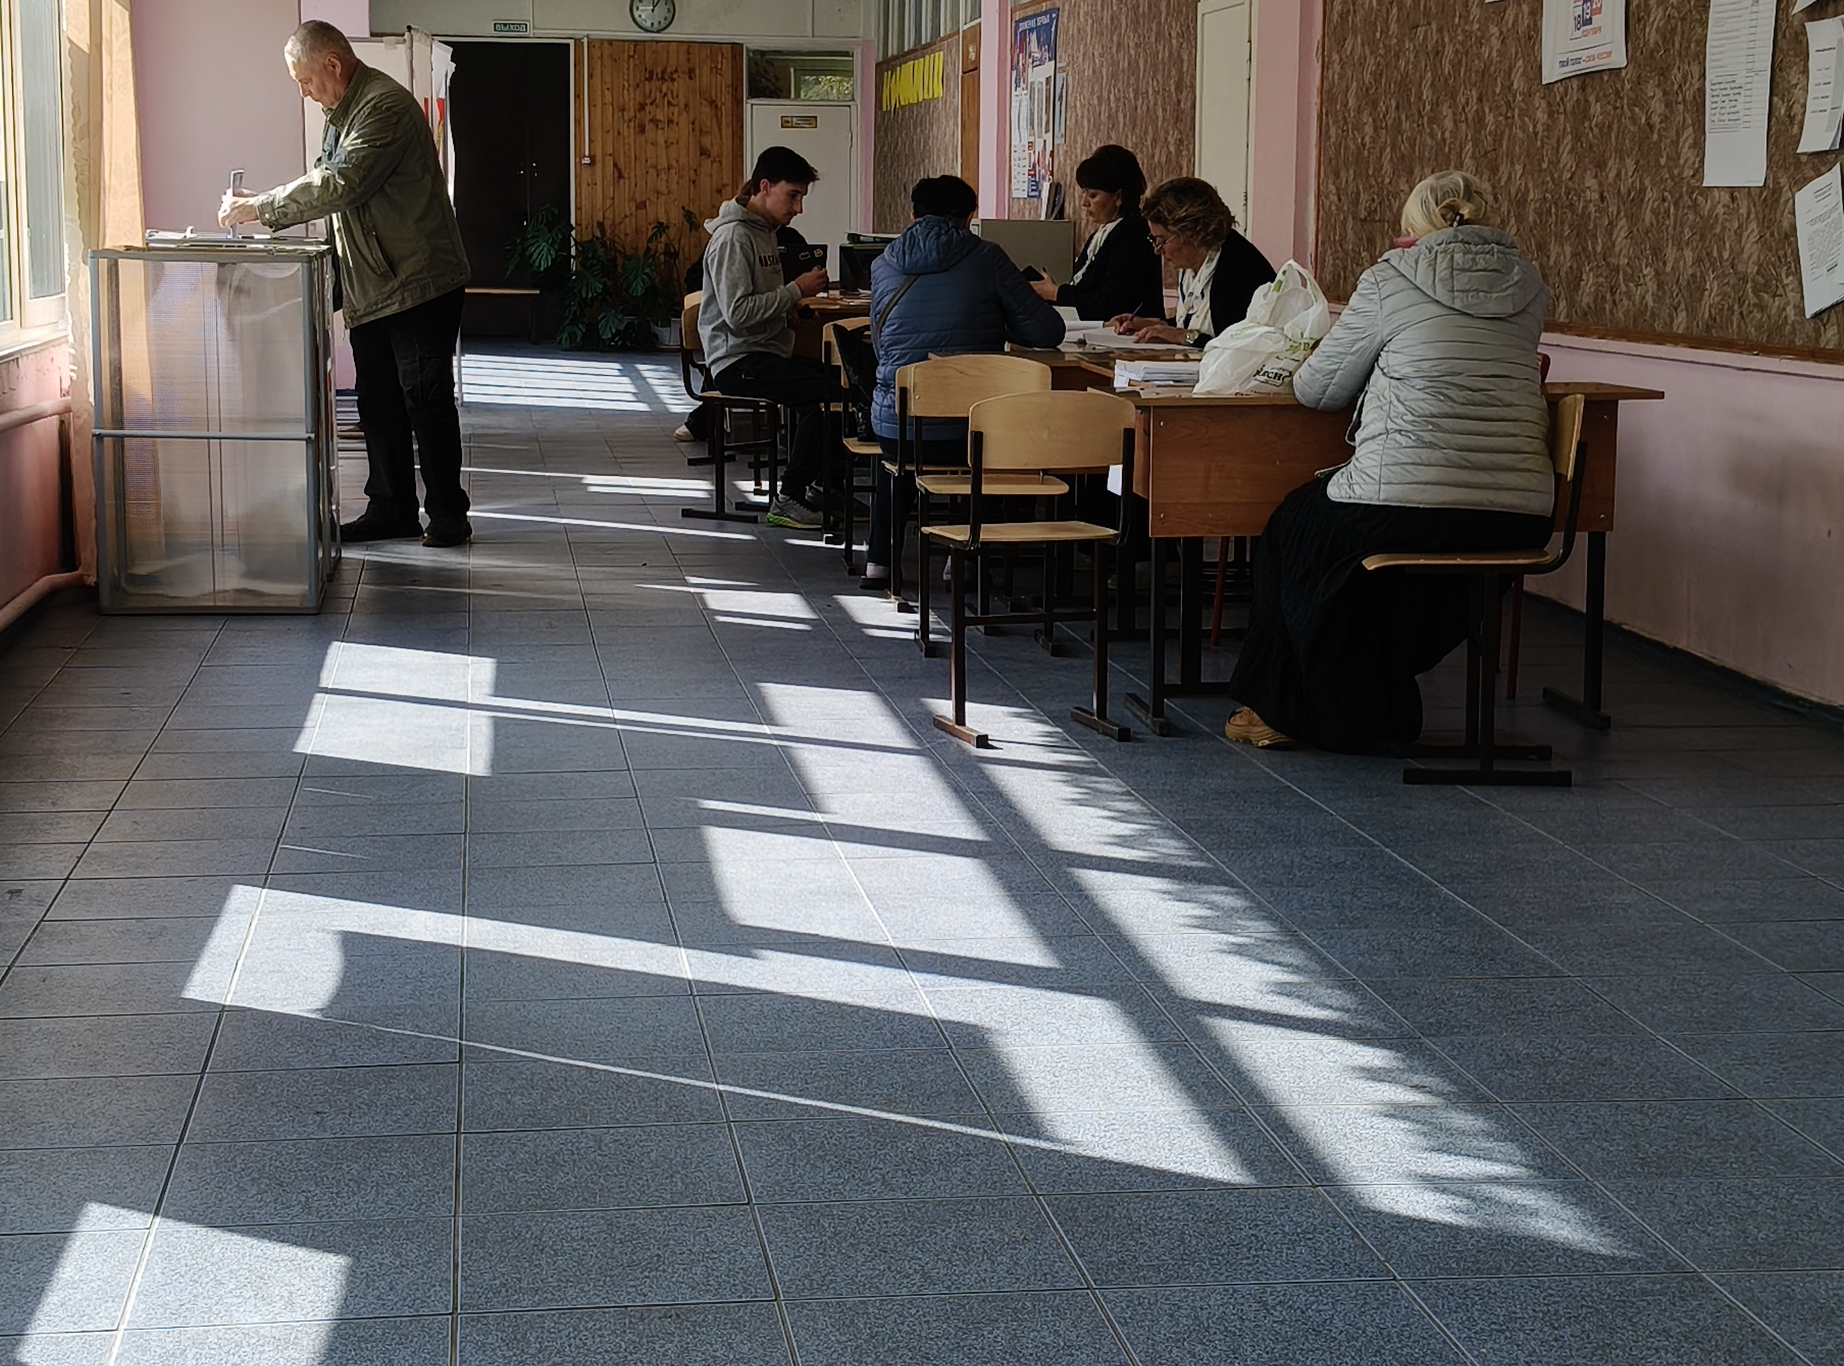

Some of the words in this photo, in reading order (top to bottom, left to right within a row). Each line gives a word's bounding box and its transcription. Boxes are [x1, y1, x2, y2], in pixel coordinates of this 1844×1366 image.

[1582, 1, 1592, 23] 19
[495, 23, 526, 32] ВЫХОД
[1573, 13, 1581, 33] 18
